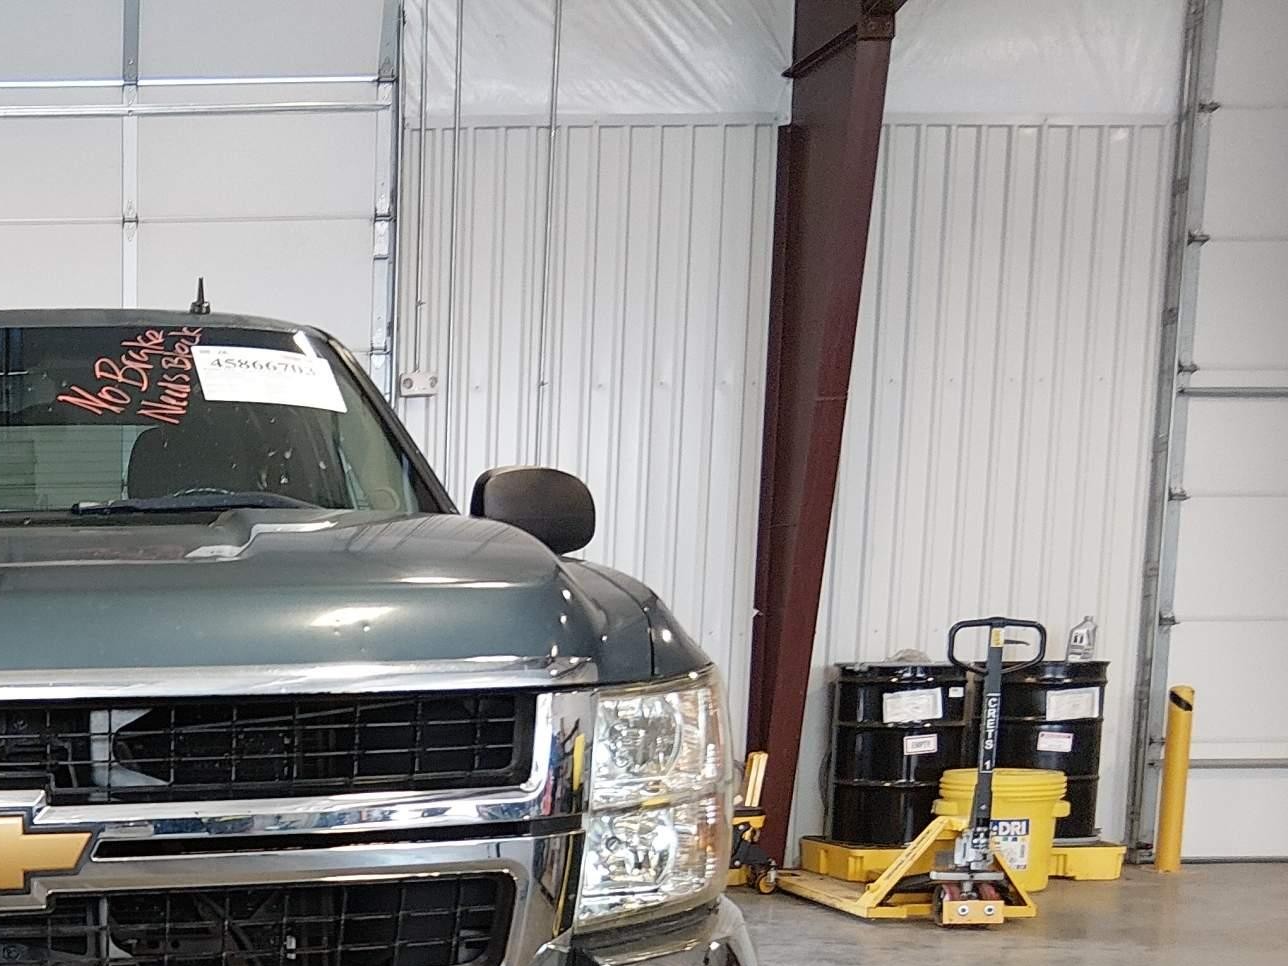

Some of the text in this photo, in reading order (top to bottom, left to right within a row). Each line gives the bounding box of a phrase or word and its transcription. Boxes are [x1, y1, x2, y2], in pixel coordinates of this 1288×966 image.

[57, 329, 165, 415] No Brake
[984, 697, 998, 770] CRETS 1
